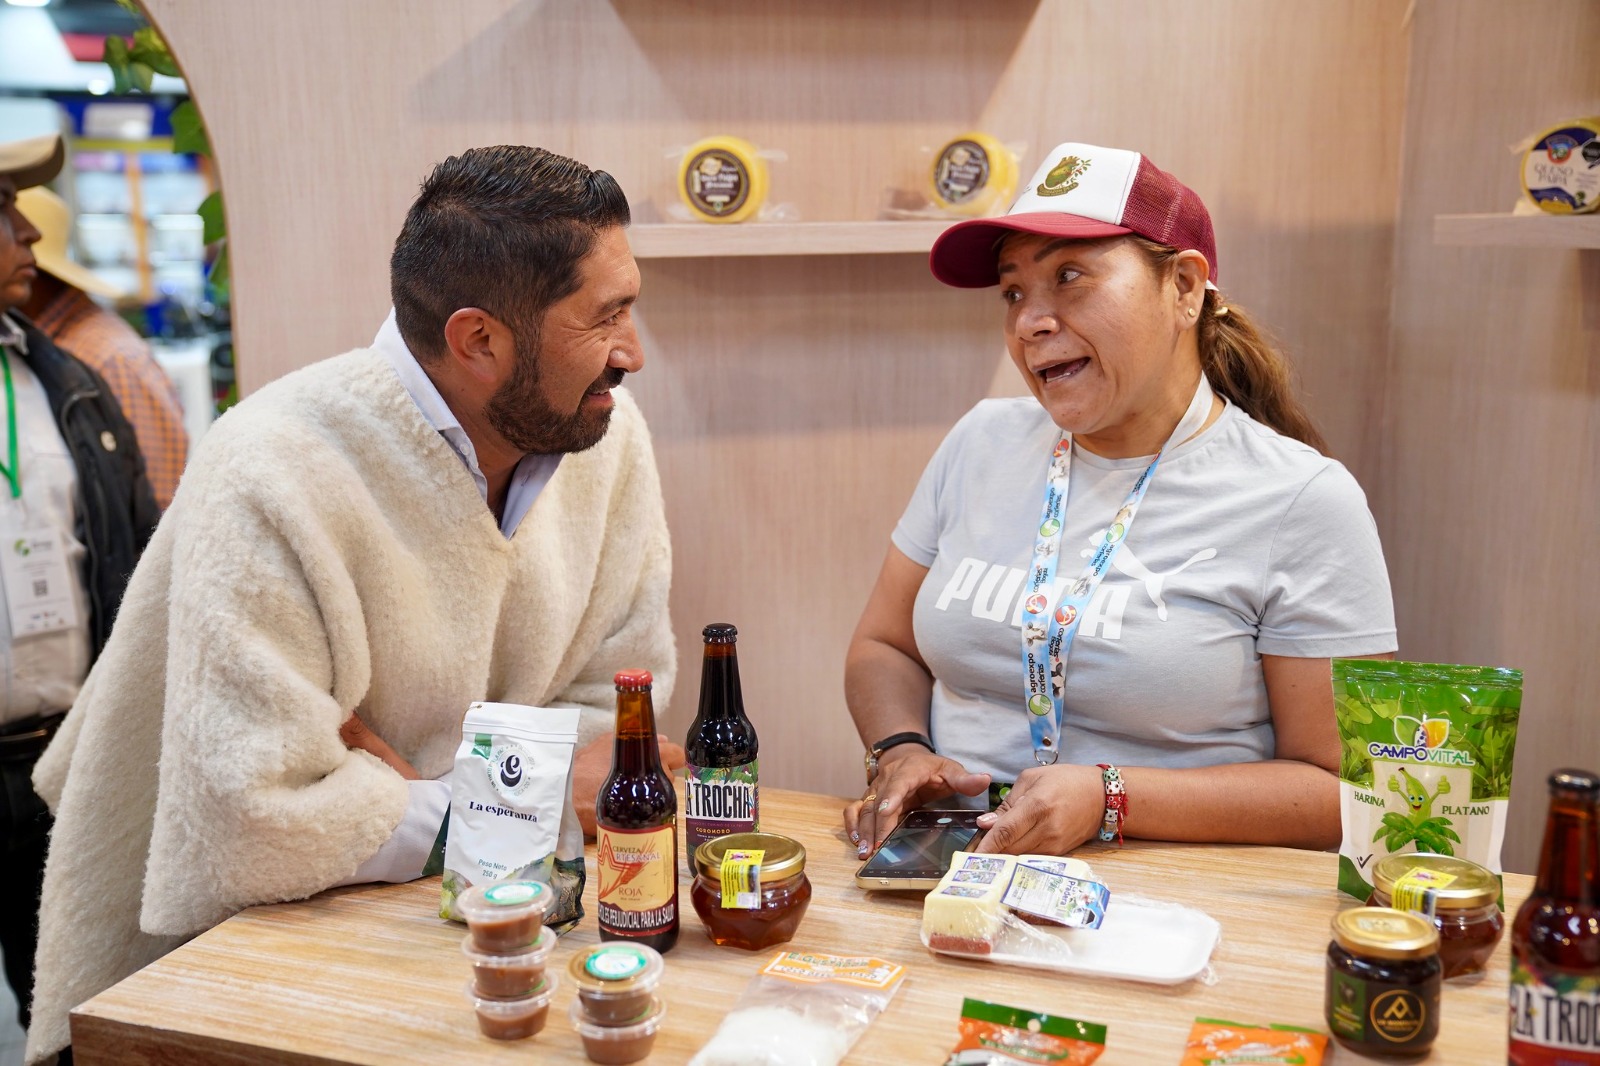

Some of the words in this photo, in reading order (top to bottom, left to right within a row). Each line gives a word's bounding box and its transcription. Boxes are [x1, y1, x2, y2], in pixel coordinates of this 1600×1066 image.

[1045, 487, 1056, 519] agroexpo
[1052, 494, 1062, 517] corferias
[1093, 544, 1115, 577] agroexpo
[1033, 567, 1043, 592] corferias
[1054, 628, 1065, 658] corferias
[1027, 652, 1038, 693] agroexpo
[1036, 663, 1046, 693] corferias
[1368, 743, 1474, 765] CAMPOVITAL
[693, 782, 751, 819] TROCHA
[1354, 791, 1386, 808] HARINA
[1442, 805, 1490, 816] PLATANO
[469, 801, 483, 811] La
[485, 804, 538, 823] esperanza
[613, 845, 642, 854] CERVEZA
[479, 859, 492, 869] Peso
[482, 869, 492, 878] 250
[618, 887, 643, 898] ROJA
[1060, 880, 1076, 906] Pradera
[610, 908, 640, 929] PERJUDICIAL
[641, 909, 655, 929] PARA
[655, 910, 663, 926] LA
